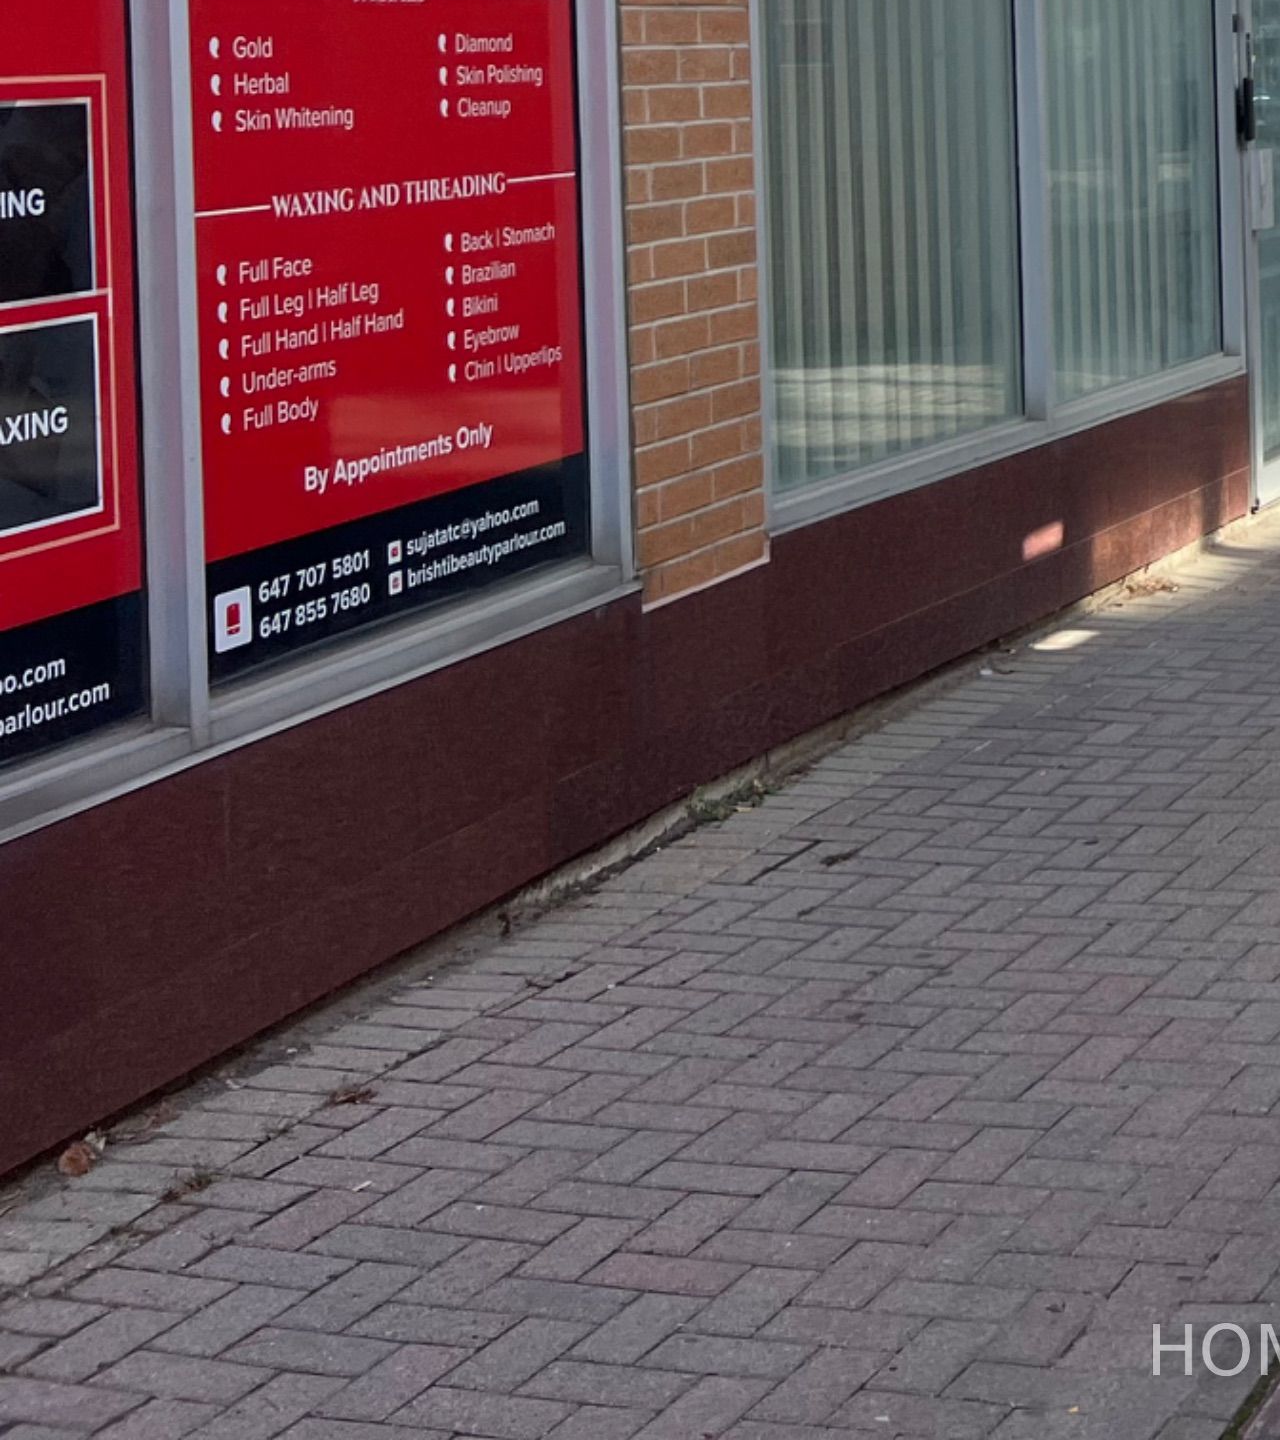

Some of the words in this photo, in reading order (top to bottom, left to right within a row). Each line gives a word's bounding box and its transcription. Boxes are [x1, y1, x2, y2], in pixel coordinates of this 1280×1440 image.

[233, 36, 273, 59] Gold
[455, 33, 513, 54] Diamond
[234, 72, 290, 95] Herbal
[456, 66, 485, 86] Skin
[487, 63, 543, 85] Polishing
[235, 109, 271, 132] Skin
[275, 105, 354, 130] Whitening
[457, 98, 511, 119] Cleanup
[272, 188, 354, 219] WAXING
[358, 183, 400, 210] AND
[404, 172, 506, 205] THREADING
[461, 229, 493, 252] Back
[502, 222, 555, 247] Stomach
[239, 259, 269, 284] Full
[273, 256, 313, 279] Face
[462, 260, 517, 285] Brazilian
[240, 295, 269, 321] Full
[274, 293, 304, 318] Leg
[316, 283, 349, 308] Half
[351, 281, 379, 305] Leg
[462, 293, 498, 317] Bikini
[241, 331, 271, 358] Full
[275, 323, 318, 351] Hand
[330, 316, 361, 341] Half
[365, 308, 404, 335] Hand
[464, 324, 520, 353] Eyebrow
[242, 360, 337, 394] Under-arms
[464, 358, 494, 381] Chin
[503, 345, 563, 374] Upperlips
[243, 404, 273, 431] Full
[277, 396, 319, 424] Body
[304, 465, 329, 494] By
[333, 433, 453, 485] Appointments
[456, 421, 493, 450] Only
[406, 499, 540, 556] sujatatc@yahoo.com
[407, 520, 566, 588] brishtibeautyparlour.com
[258, 574, 290, 604] 647
[295, 566, 326, 592] 707
[332, 549, 370, 580] 5801
[259, 609, 291, 639] 647
[294, 597, 327, 627] 855
[331, 582, 371, 615] 7680
[0, 658, 65, 695] o.com
